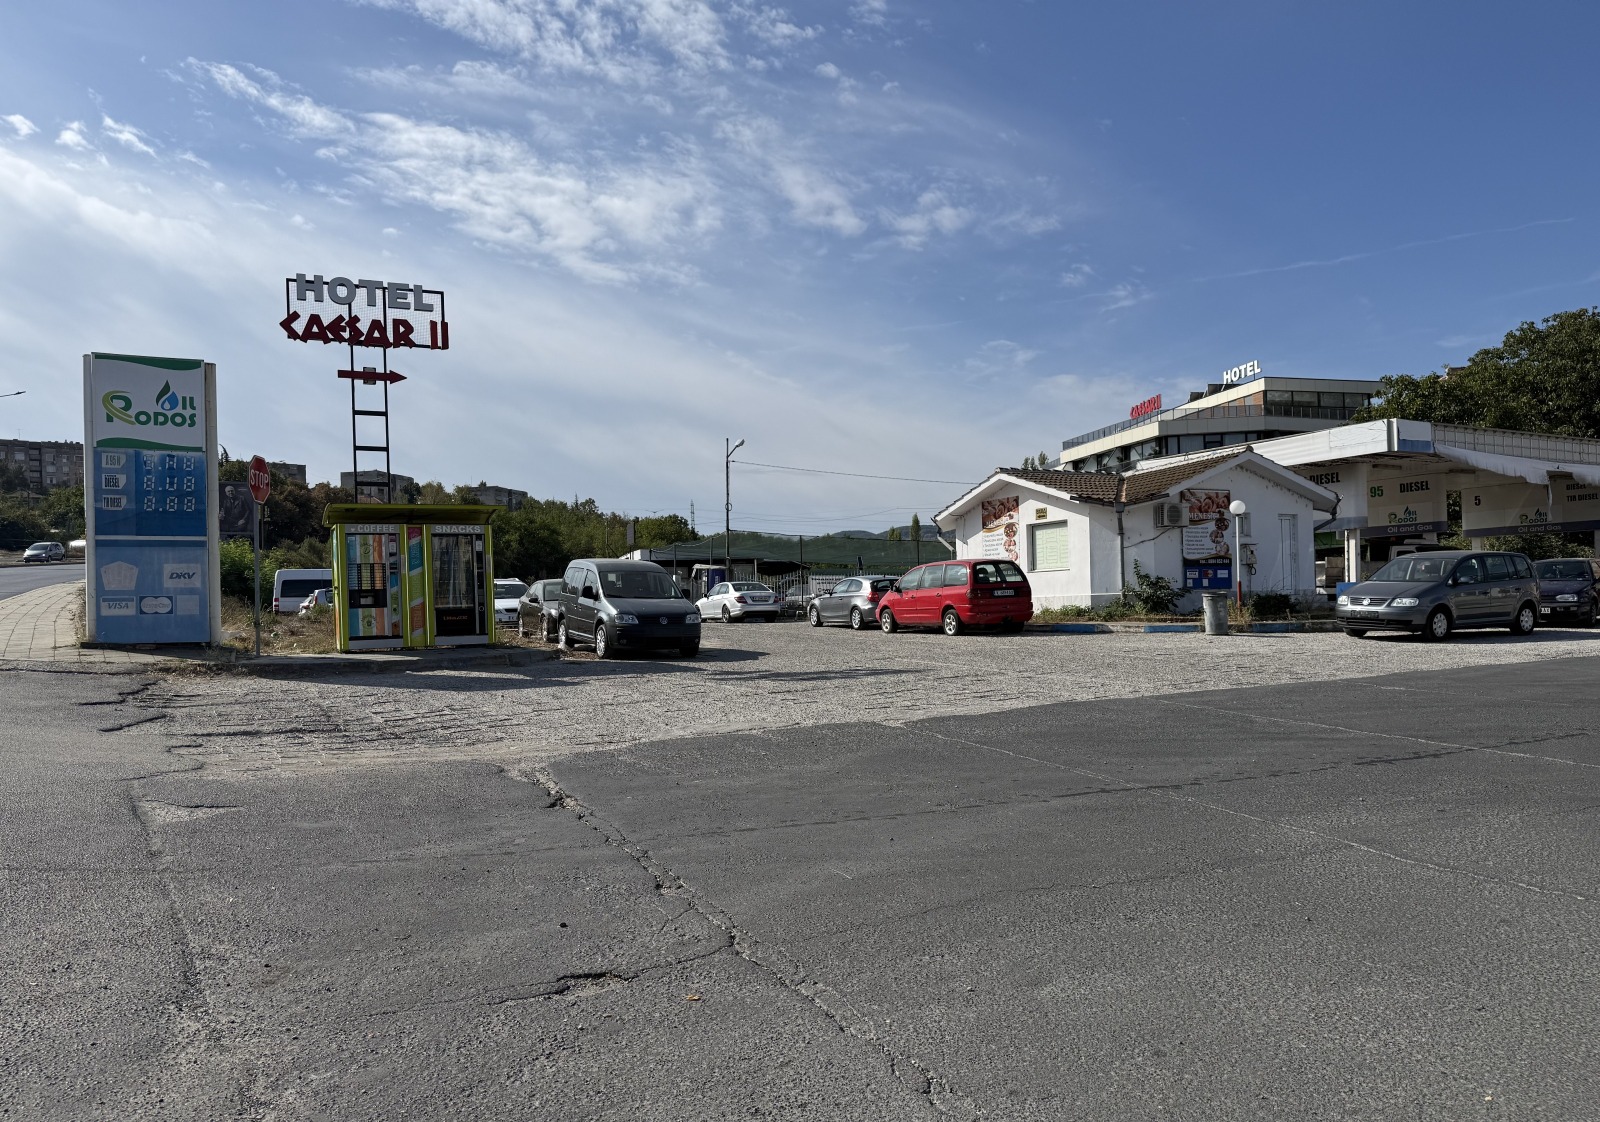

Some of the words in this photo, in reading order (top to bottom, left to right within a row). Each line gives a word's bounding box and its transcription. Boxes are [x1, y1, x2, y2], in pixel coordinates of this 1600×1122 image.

[296, 273, 434, 312] HOTEL
[279, 310, 417, 349] CAESAR
[430, 320, 449, 350] II
[1223, 360, 1261, 384] HOTEL
[250, 469, 269, 489] STOP
[1369, 486, 1384, 498] 95
[1400, 481, 1430, 494] DIESEL
[1474, 496, 1481, 506] 5
[1577, 492, 1599, 501] DIESEL
[357, 524, 395, 532] COFFEE
[435, 525, 481, 533] SNACKS
[1387, 525, 1398, 533] Oil
[1400, 525, 1415, 533] and
[1417, 523, 1433, 532] Gas
[1530, 525, 1545, 533] and
[1546, 523, 1562, 531] Gas
[169, 571, 196, 580] DKV
[107, 602, 129, 610] VISA
